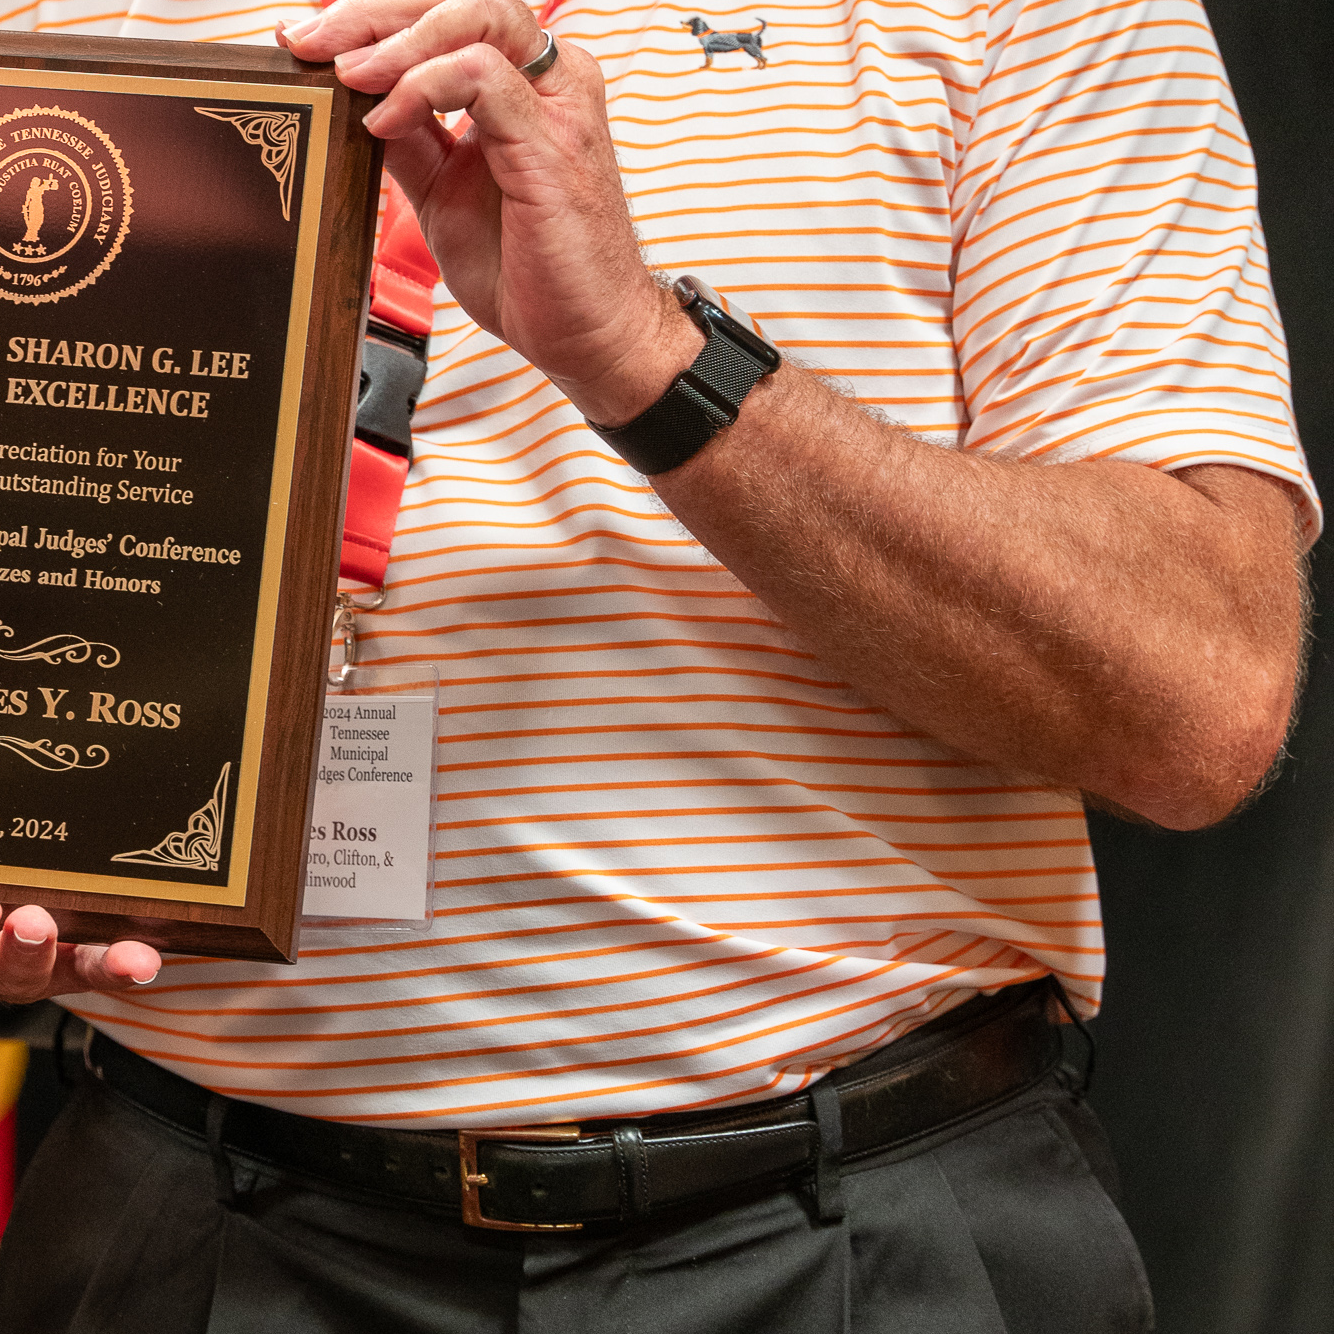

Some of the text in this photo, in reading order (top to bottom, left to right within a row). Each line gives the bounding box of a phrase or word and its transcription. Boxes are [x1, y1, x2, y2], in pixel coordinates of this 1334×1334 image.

[10, 127, 94, 160] TENNESSEE
[91, 161, 114, 246] JUDICIARY
[42, 157, 72, 179] RUAT
[67, 181, 83, 233] COELUM
[12, 273, 41, 286] 1796
[7, 336, 144, 369] SHARON
[152, 348, 181, 374] G.
[190, 350, 251, 379] LEE
[5, 379, 211, 418] EXCELLENCE
[96, 446, 128, 468] for
[133, 450, 182, 472] Your
[116, 480, 194, 505] Service
[34, 528, 112, 556] Judges’
[119, 535, 242, 565] Conference
[37, 567, 77, 588] and
[84, 571, 162, 595] Honors
[38, 687, 75, 720] Y.
[323, 705, 396, 722] 2024 Annual
[330, 725, 390, 740] Tennessee
[330, 746, 388, 764] Municipal
[316, 766, 413, 784] dges Conference
[10, 817, 69, 842] 2024
[332, 821, 377, 842] Ross
[333, 849, 380, 869] Clifton,
[383, 850, 394, 867] &
